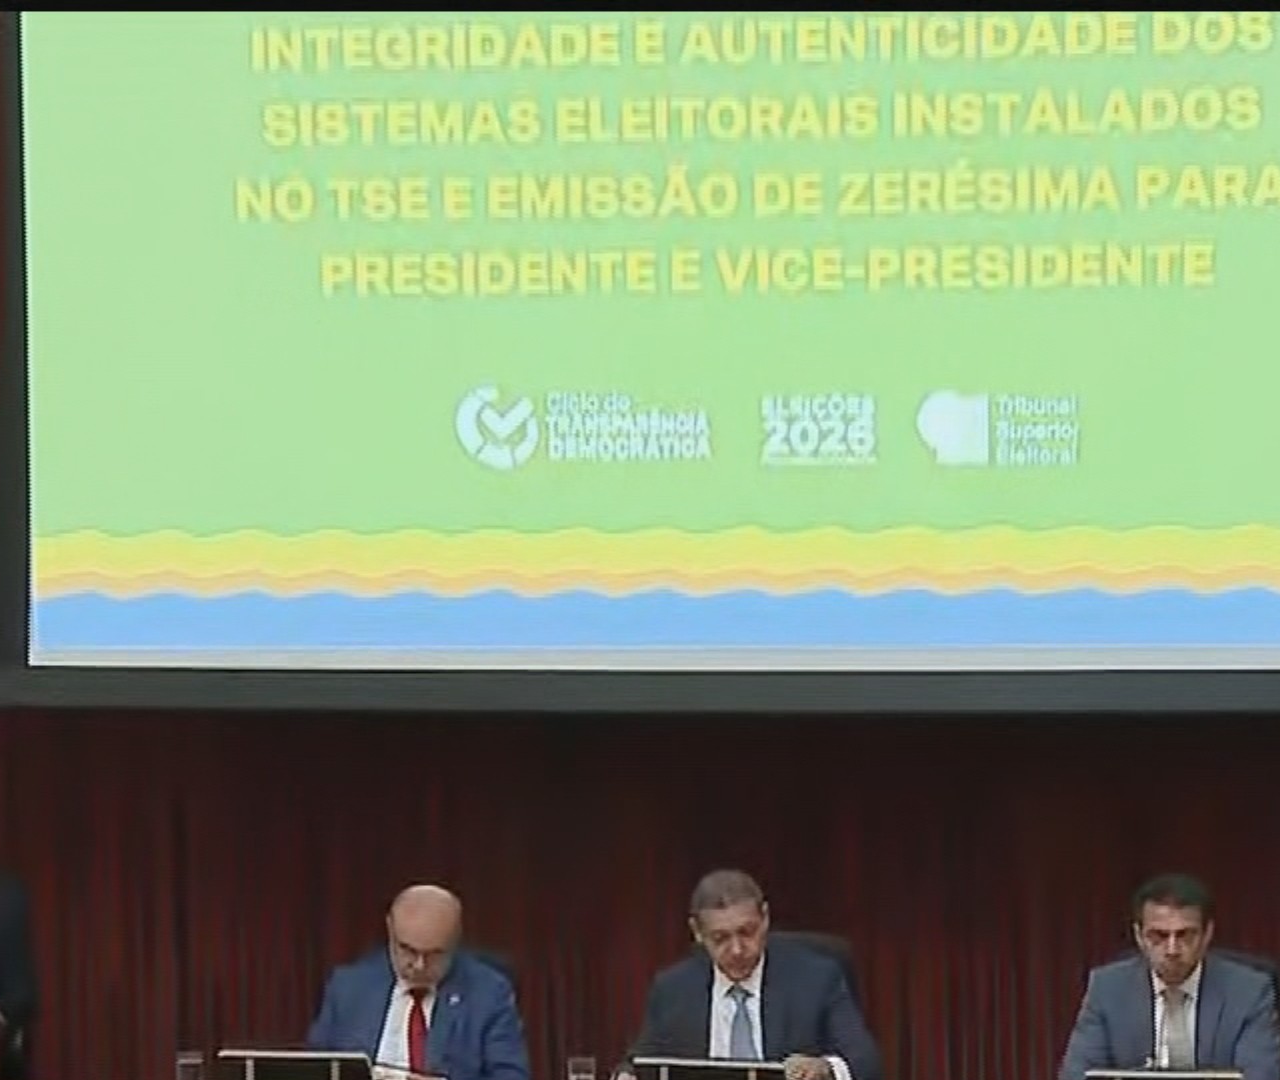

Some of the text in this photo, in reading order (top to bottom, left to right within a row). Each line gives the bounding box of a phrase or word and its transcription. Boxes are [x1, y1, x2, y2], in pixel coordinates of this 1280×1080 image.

[250, 11, 1274, 72] INTEGRIDADE E AUTENTICIDADE DOS
[261, 86, 1262, 147] SISTEMAS ELEITORAIS INSTALADOS
[235, 178, 314, 223] NO
[330, 177, 429, 220] TSE
[444, 177, 473, 218] E
[488, 164, 738, 219] EMISSÃO
[754, 173, 823, 217] DE
[838, 160, 1120, 216] ZERÉSIMA
[321, 241, 1217, 298] PRESIDENTE E VICE-PRESIDENTE
[764, 420, 876, 457] 2026
